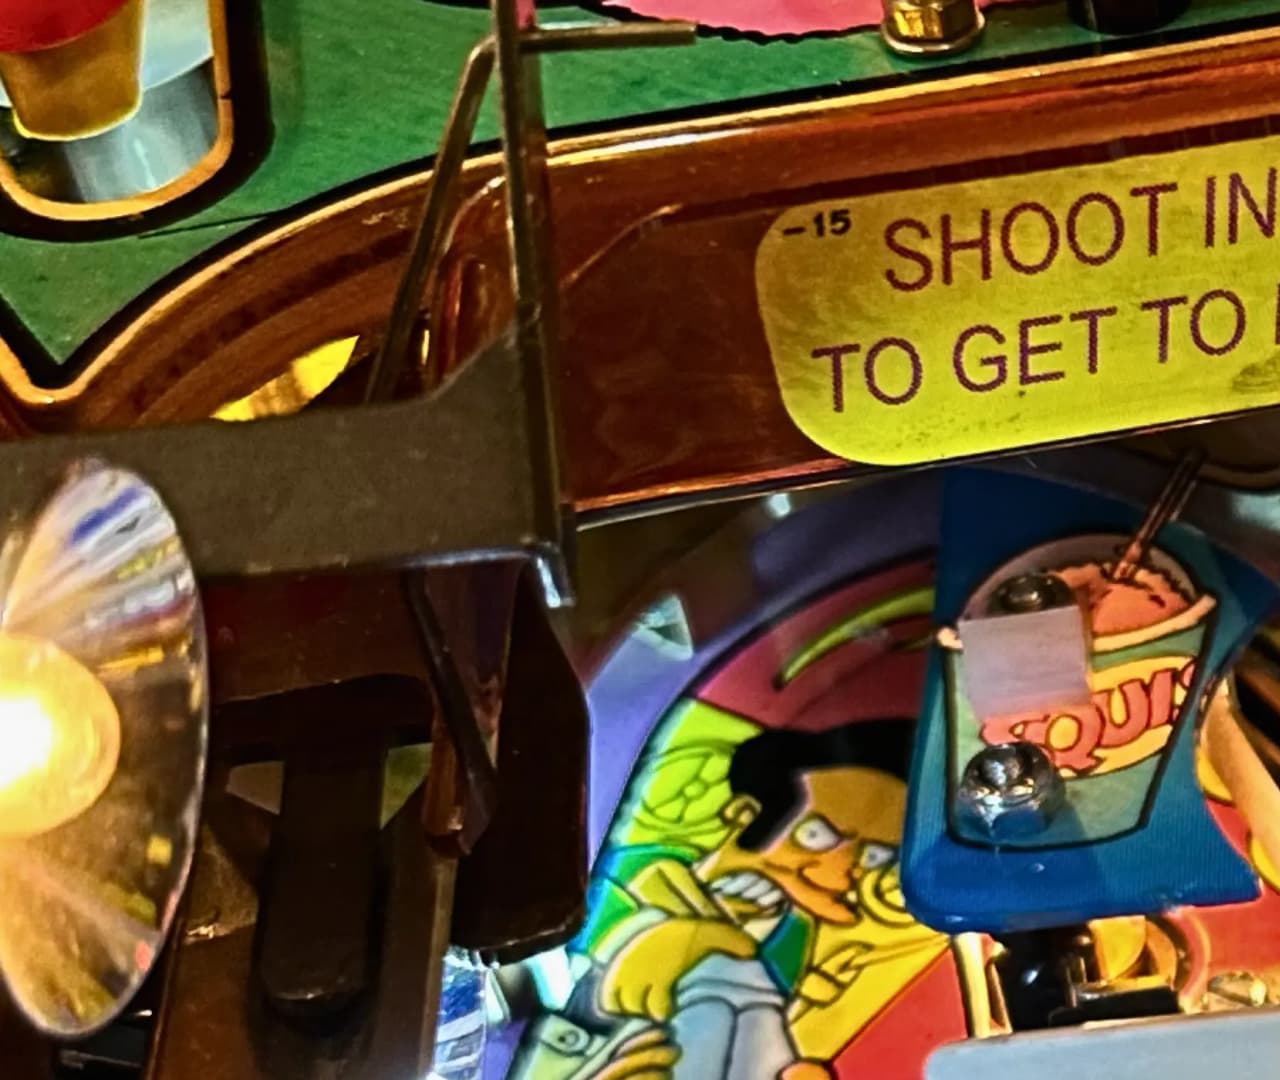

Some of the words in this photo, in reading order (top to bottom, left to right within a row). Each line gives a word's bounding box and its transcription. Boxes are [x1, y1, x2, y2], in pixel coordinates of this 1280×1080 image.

[884, 182, 1178, 292] SHOOT
[812, 337, 922, 412] TO
[953, 306, 1117, 392] GET
[1141, 290, 1246, 363] TO
